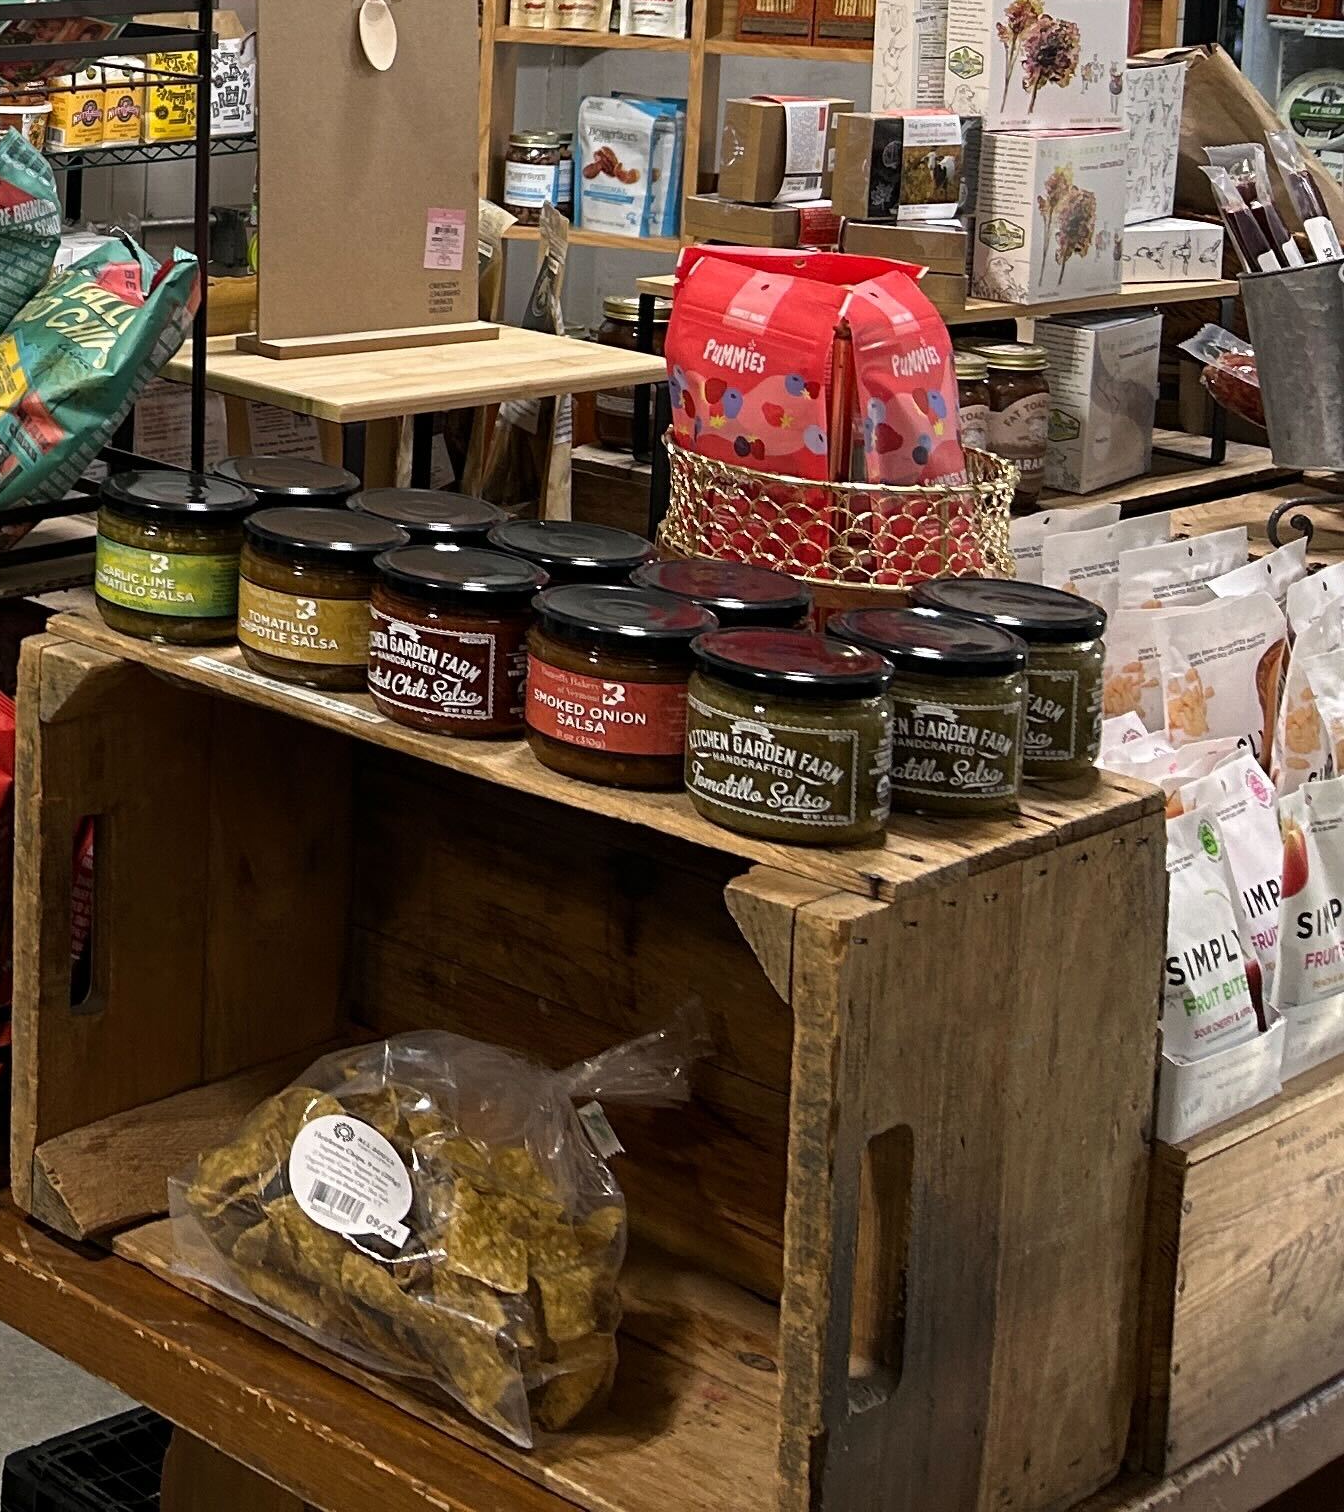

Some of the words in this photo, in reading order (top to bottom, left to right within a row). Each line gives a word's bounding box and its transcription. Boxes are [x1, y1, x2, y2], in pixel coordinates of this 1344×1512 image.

[103, 565, 140, 585] GARLIC
[143, 573, 176, 588] LIME
[150, 588, 195, 603] SALSA
[249, 609, 319, 636] TOMATILLO
[291, 635, 339, 650] SALSA
[378, 650, 435, 676] HANDCRAFTED
[390, 635, 438, 665] GARDEN
[440, 653, 481, 683] FARM
[392, 671, 428, 699] Chili
[431, 680, 482, 704] Salsa
[534, 690, 584, 716] SMOKED
[590, 708, 646, 725] ONION
[557, 716, 606, 735] SALSA
[915, 720, 978, 744] GARDEN
[981, 729, 1012, 757] FARM
[689, 730, 729, 752] KITCHEN
[733, 736, 796, 770] GARDEN
[799, 754, 844, 786] FARM
[713, 752, 793, 779] HANDCRAFTED
[890, 758, 946, 782] atillo
[950, 761, 1003, 786] Salsa
[692, 761, 764, 803] Tomatillo
[767, 782, 831, 810] Salsa
[1297, 898, 1342, 939] SIMP
[1184, 989, 1220, 1016] FRUIT
[1224, 975, 1248, 1001] BITE
[366, 1214, 398, 1239] 09/21
